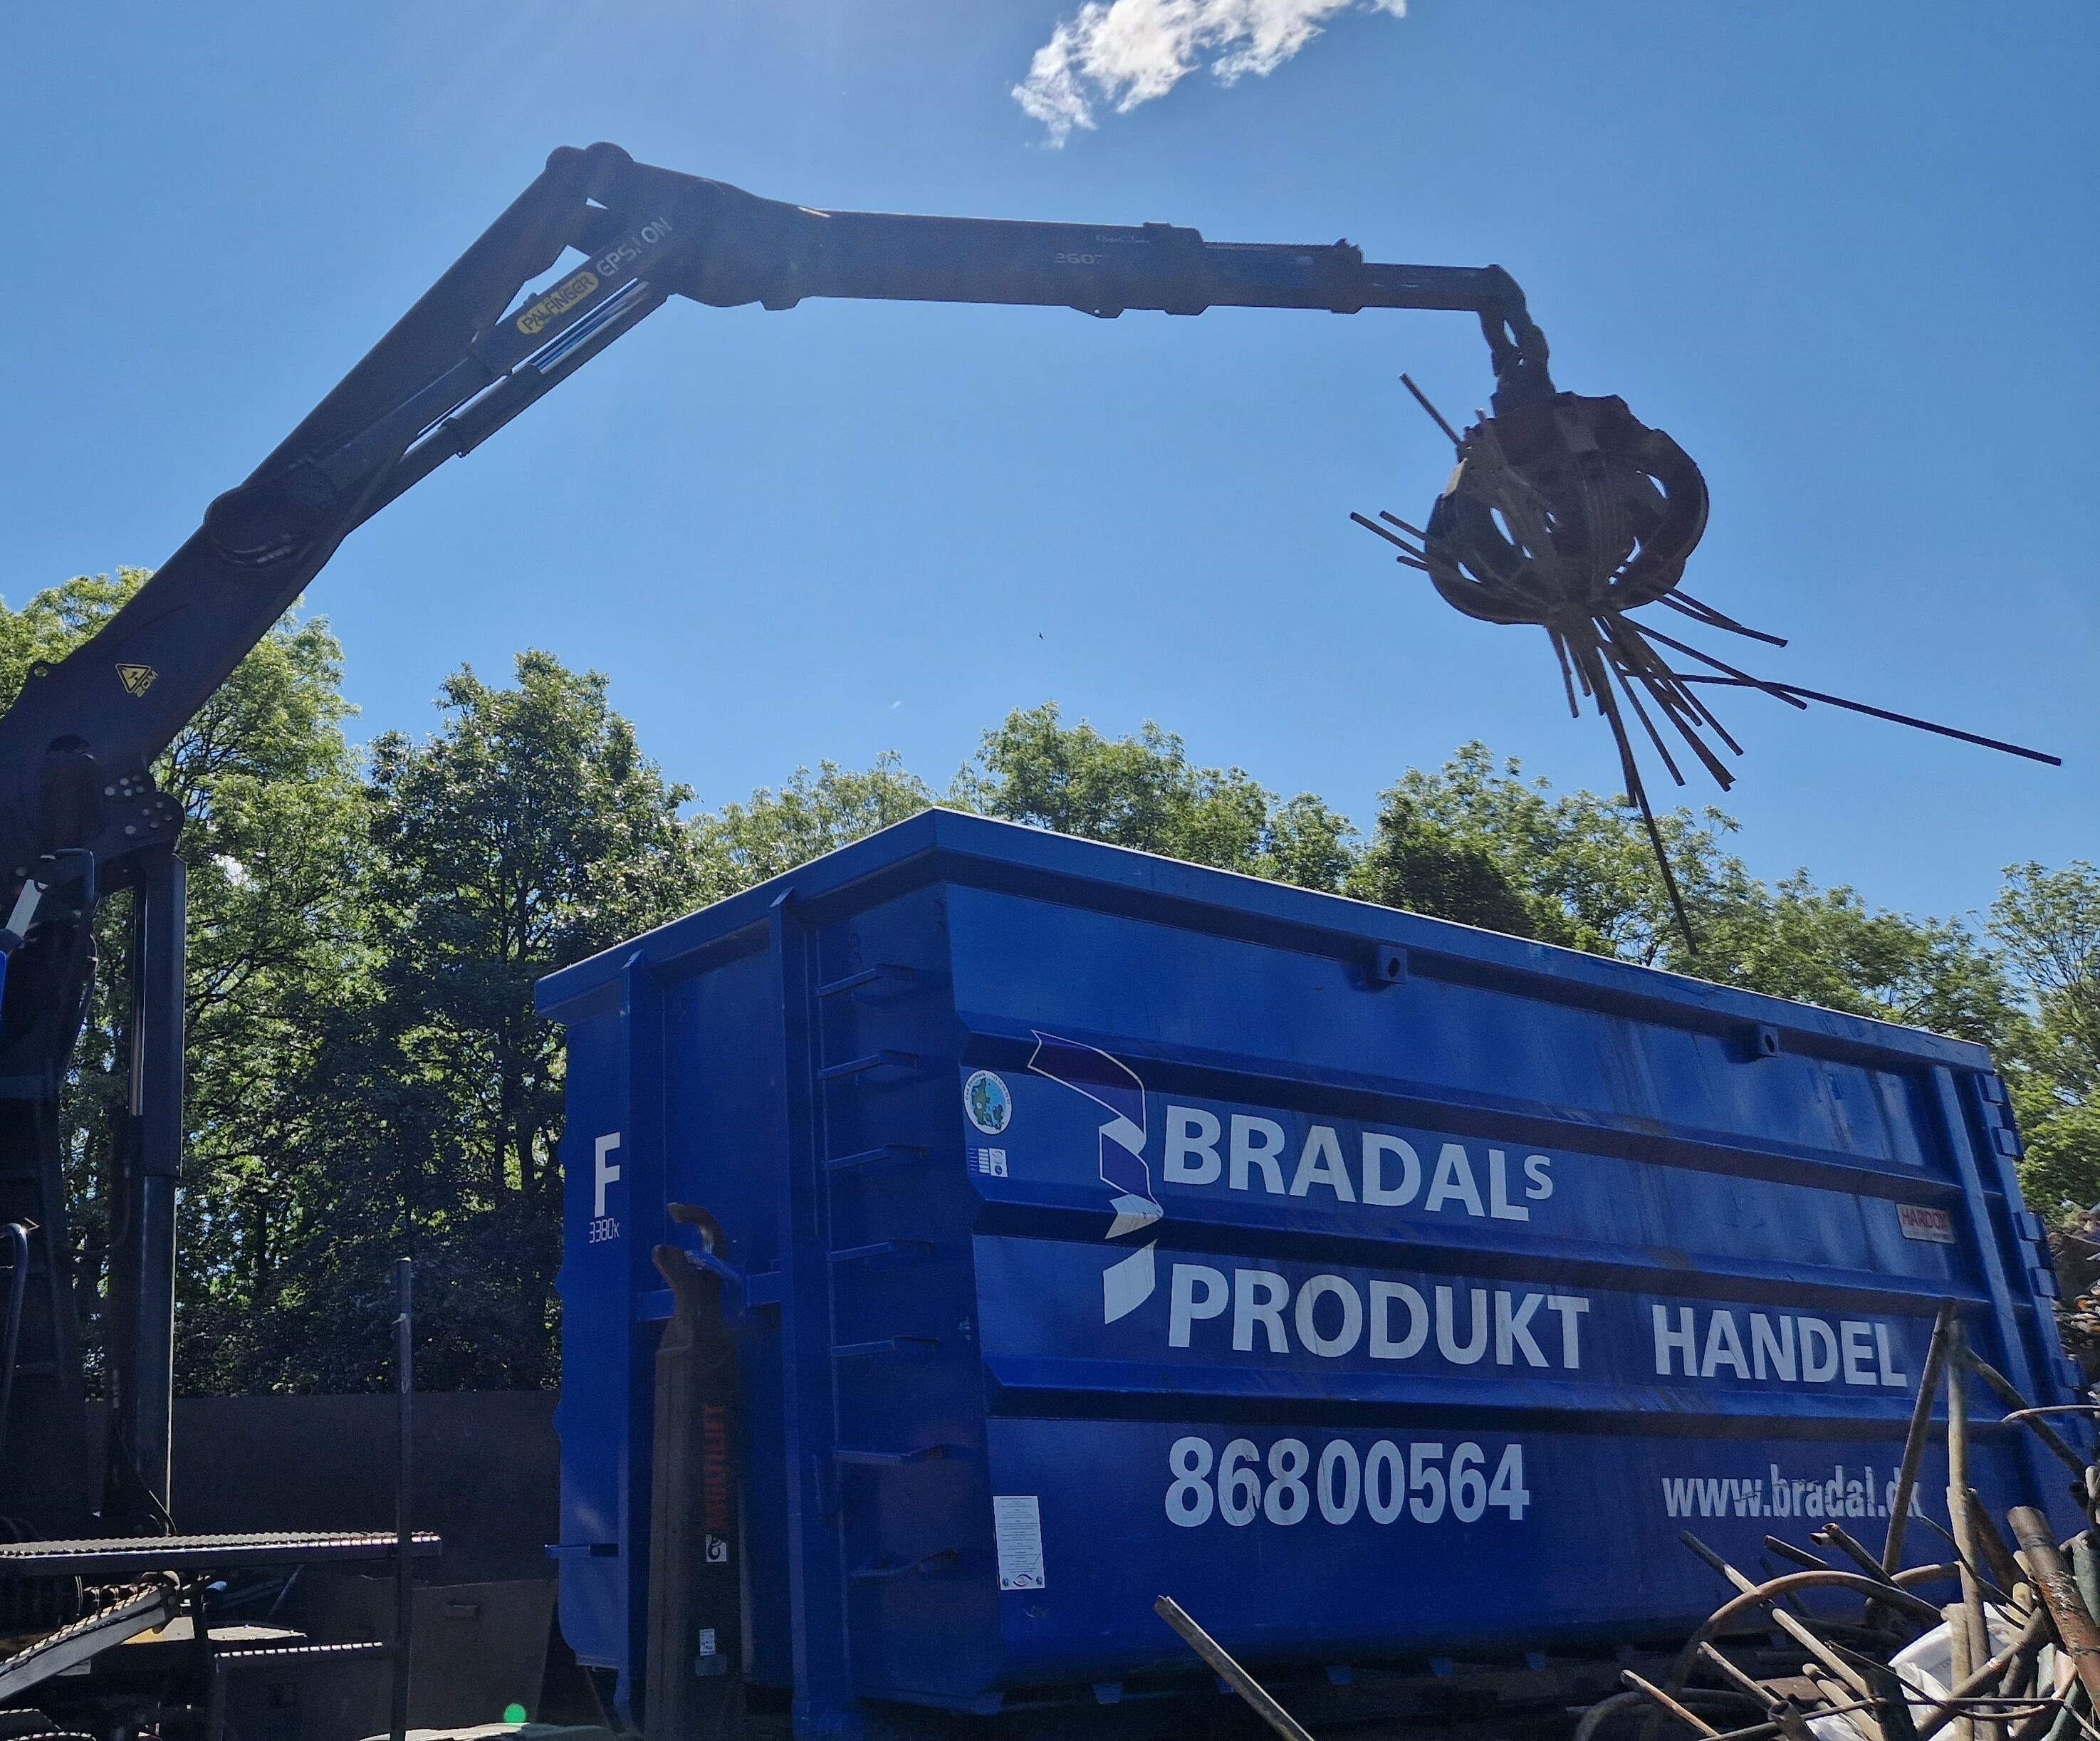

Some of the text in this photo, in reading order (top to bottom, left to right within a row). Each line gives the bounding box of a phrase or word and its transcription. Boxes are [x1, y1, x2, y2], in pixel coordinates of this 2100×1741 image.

[595, 216, 673, 276] EPSON
[594, 1131, 621, 1218] F
[1168, 1262, 1908, 1387] PRODUKT HANDEL
[1164, 1436, 1530, 1527] 86800564
